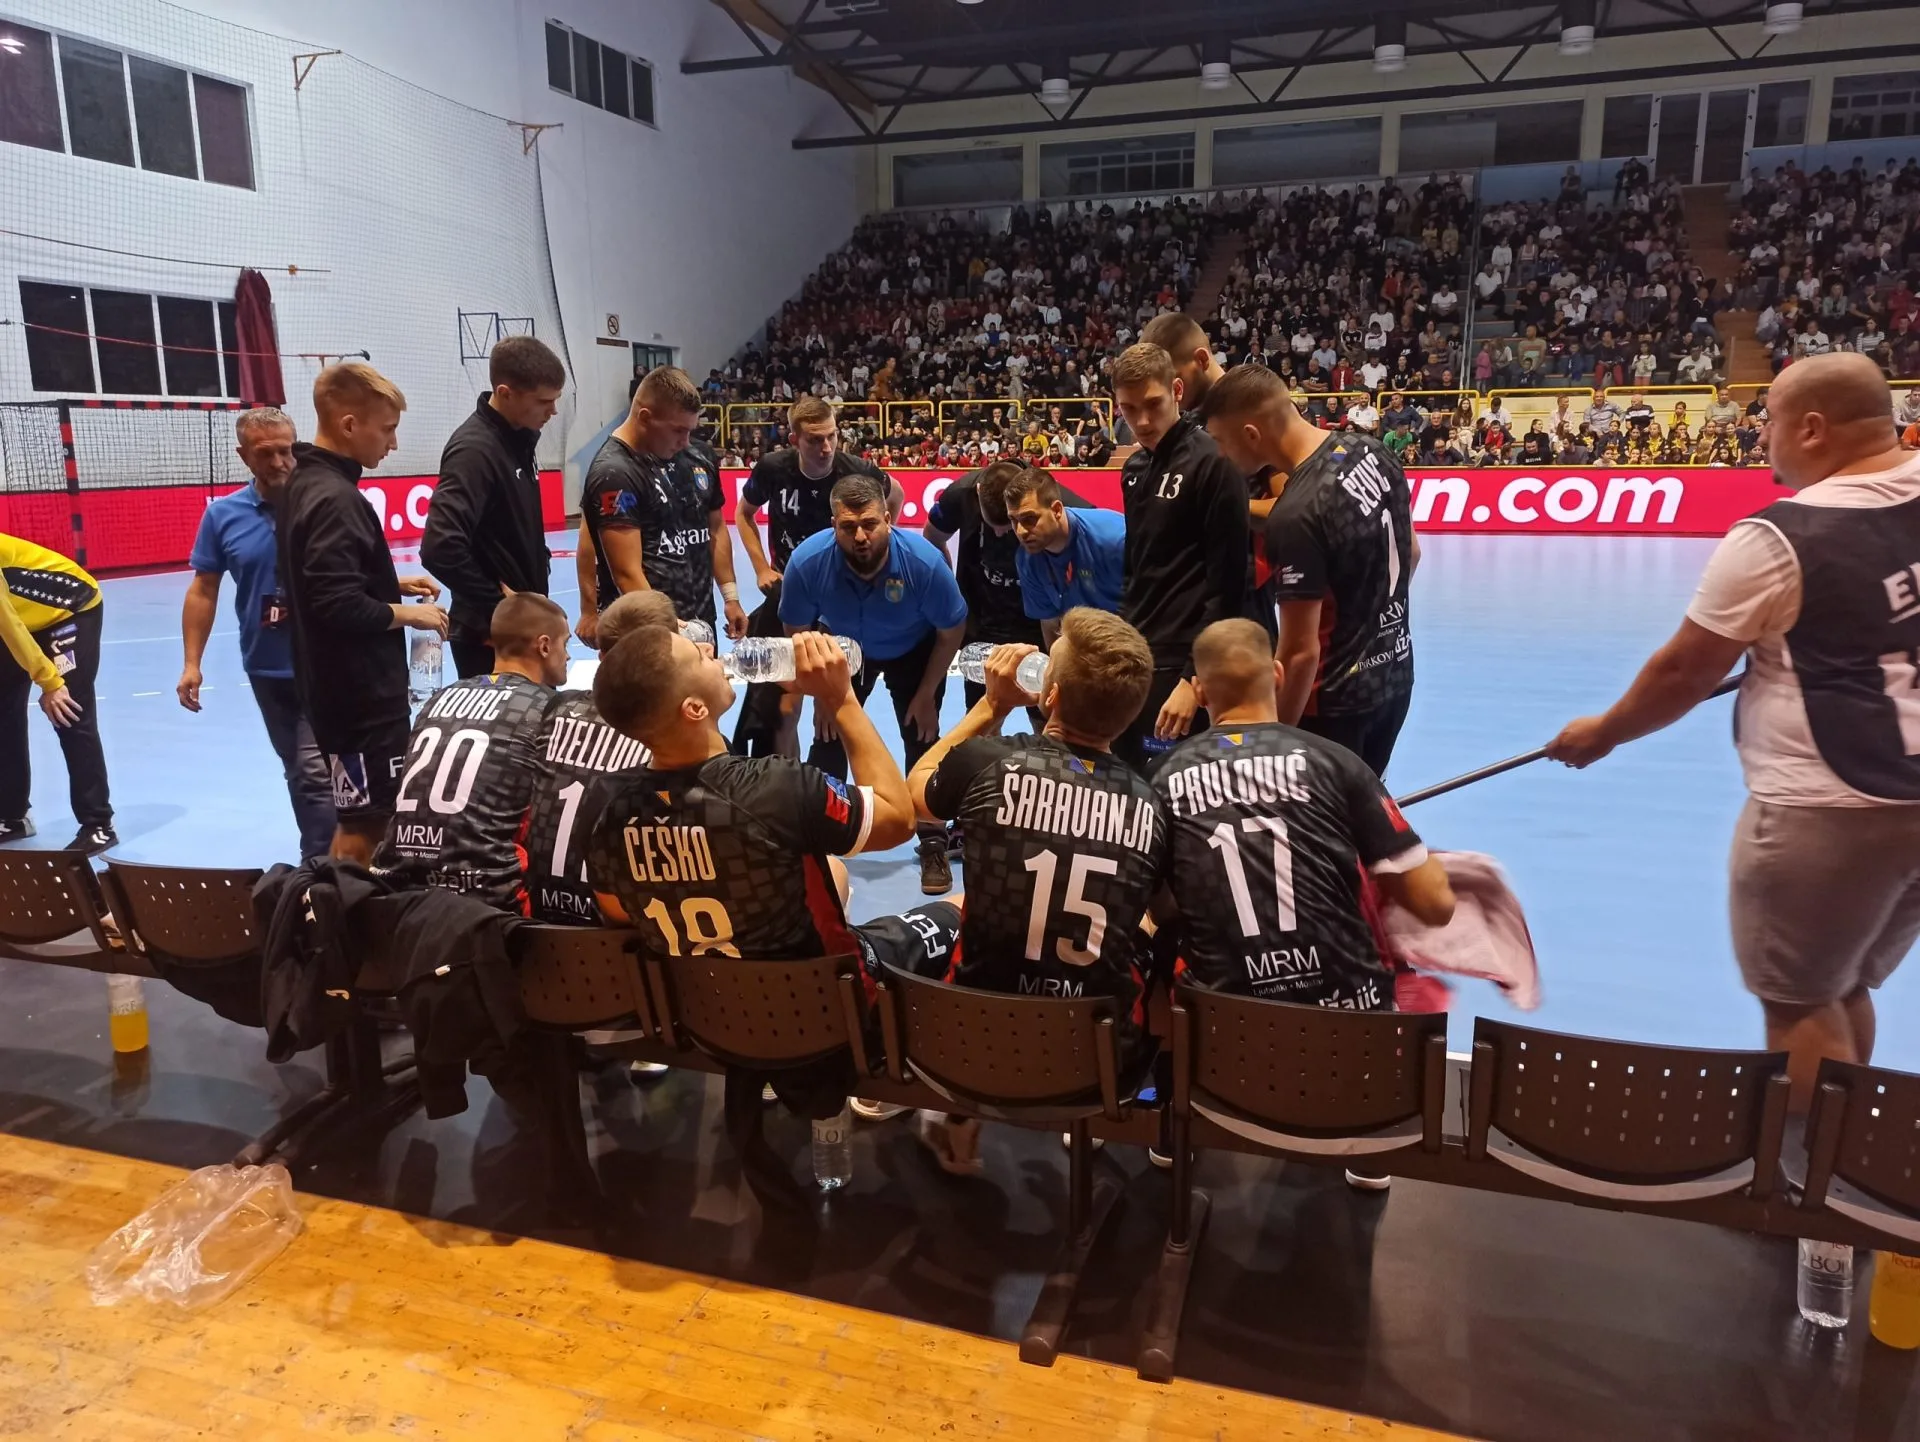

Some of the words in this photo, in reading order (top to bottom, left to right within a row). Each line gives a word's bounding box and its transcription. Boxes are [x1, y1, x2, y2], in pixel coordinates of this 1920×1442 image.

[779, 488, 801, 516] 14
[1155, 472, 1184, 500] 13
[1406, 475, 1685, 524] n.com
[427, 685, 519, 721] KOVAČ
[396, 726, 490, 815] 20
[996, 763, 1155, 855] ŠARAVANJA
[396, 824, 443, 846] MRM
[1207, 816, 1297, 938] 17
[541, 888, 592, 915] MRM
[1024, 848, 1119, 967] 15
[1244, 945, 1321, 980] MRM
[1018, 973, 1084, 998] MRM
